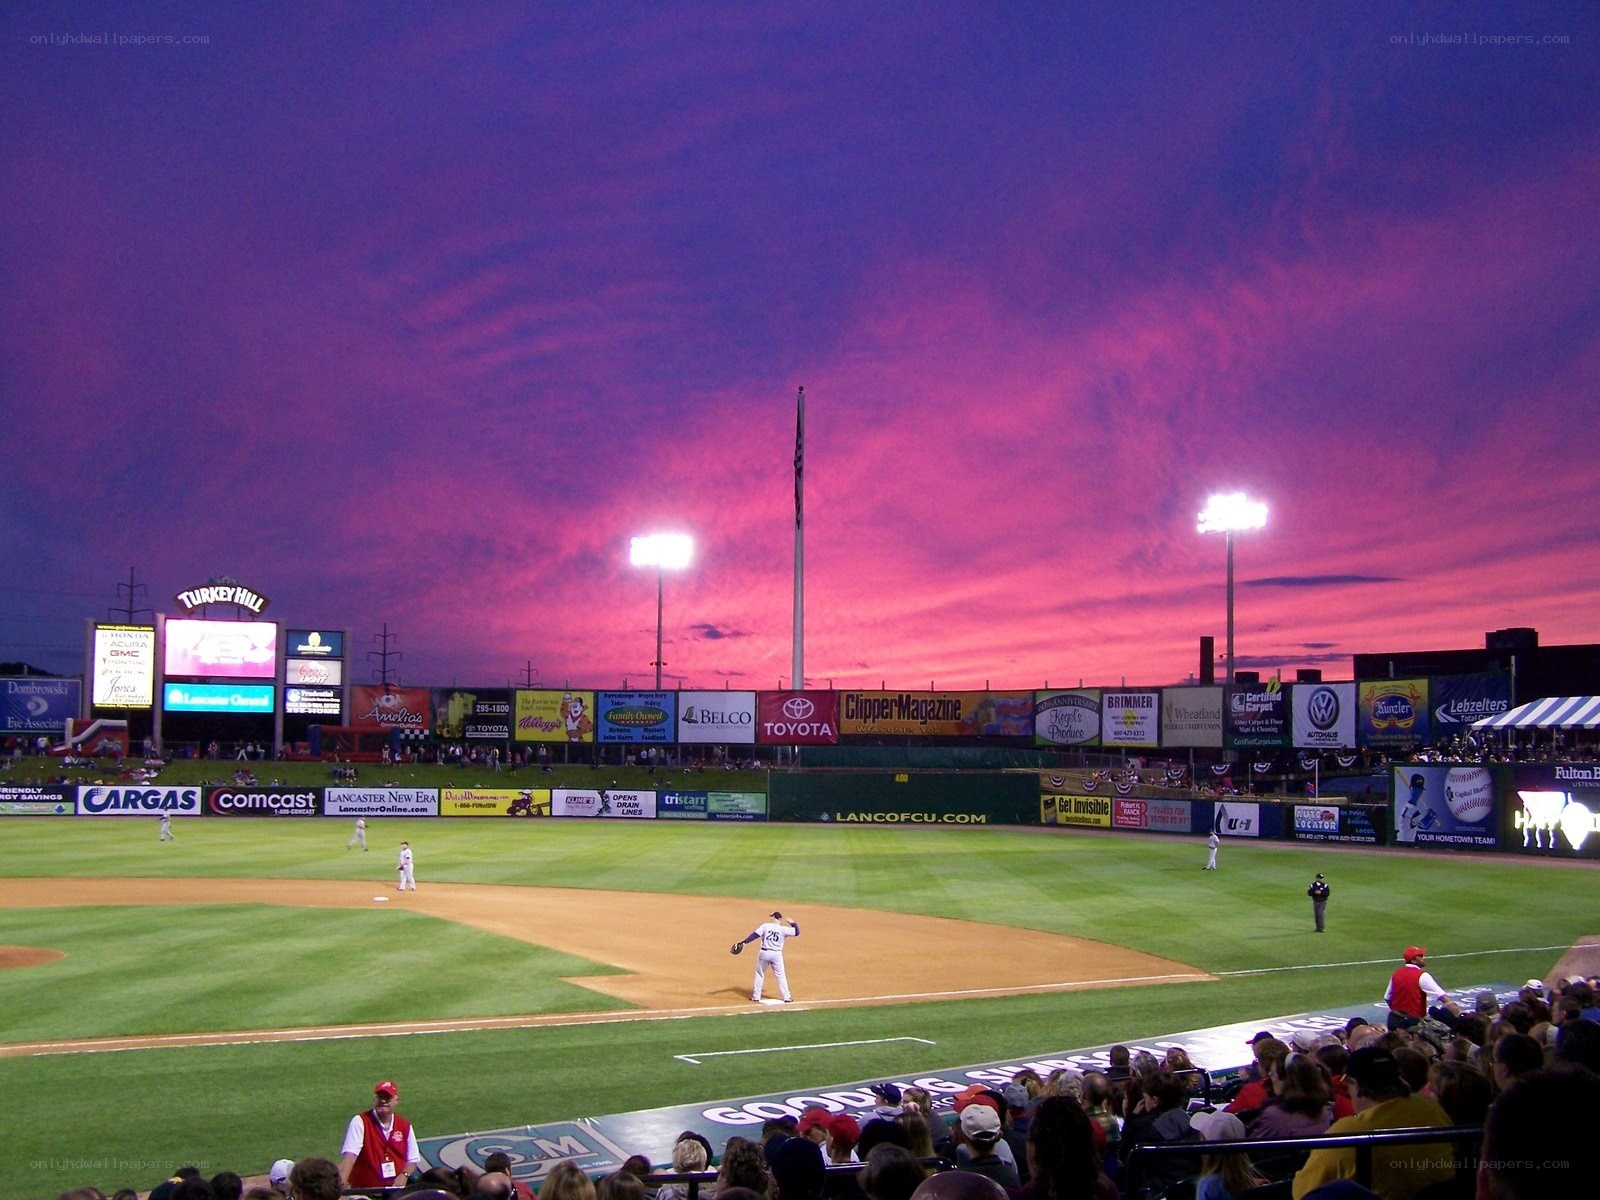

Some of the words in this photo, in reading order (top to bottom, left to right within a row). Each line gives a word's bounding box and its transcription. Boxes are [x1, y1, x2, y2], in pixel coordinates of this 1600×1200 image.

[177, 586, 235, 609] TURKEY
[234, 586, 264, 613] HILL
[299, 675, 328, 684] LIGHT
[8, 681, 68, 695] Dombrowski
[1107, 696, 1153, 708] BRIMMER
[1246, 692, 1282, 702] Certified
[476, 704, 509, 713] 295-1800
[1053, 697, 1097, 710] ANNIVERSARY
[1246, 702, 1273, 713] Carpet
[1375, 701, 1411, 716] Kunzler
[1451, 698, 1508, 713] Lebzelters
[358, 705, 423, 722] Amelia's
[608, 711, 634, 720] Family
[636, 711, 663, 720] Owned
[701, 709, 752, 725] BELCO
[1175, 708, 1220, 720] Wheatland
[7, 716, 22, 730] Eye
[25, 718, 66, 729] Associate
[518, 715, 562, 732] Kellogg's
[764, 723, 832, 736] TOYOTA
[1048, 724, 1084, 739] Produce
[895, 774, 908, 782] 400
[1555, 766, 1592, 779] Fulton
[327, 791, 386, 803] LANCASTER
[388, 791, 414, 803] NEW
[416, 791, 437, 803] ERA
[664, 793, 706, 804] tristarr
[1455, 789, 1473, 798] Capital
[83, 787, 197, 813] CARGAS
[219, 791, 316, 809] comcast
[565, 796, 595, 805] KLINE'S
[1058, 797, 1072, 813] Get
[1074, 797, 1109, 815] Invisible
[339, 805, 428, 813] LancasterOnline.com
[1296, 809, 1322, 819] AUTO
[836, 812, 987, 823] LANCOFCU.COM
[1295, 818, 1336, 831] LOCATOR
[1436, 834, 1474, 844] HOMETOWN
[766, 930, 779, 942] 25
[702, 1077, 969, 1126] GOODG
